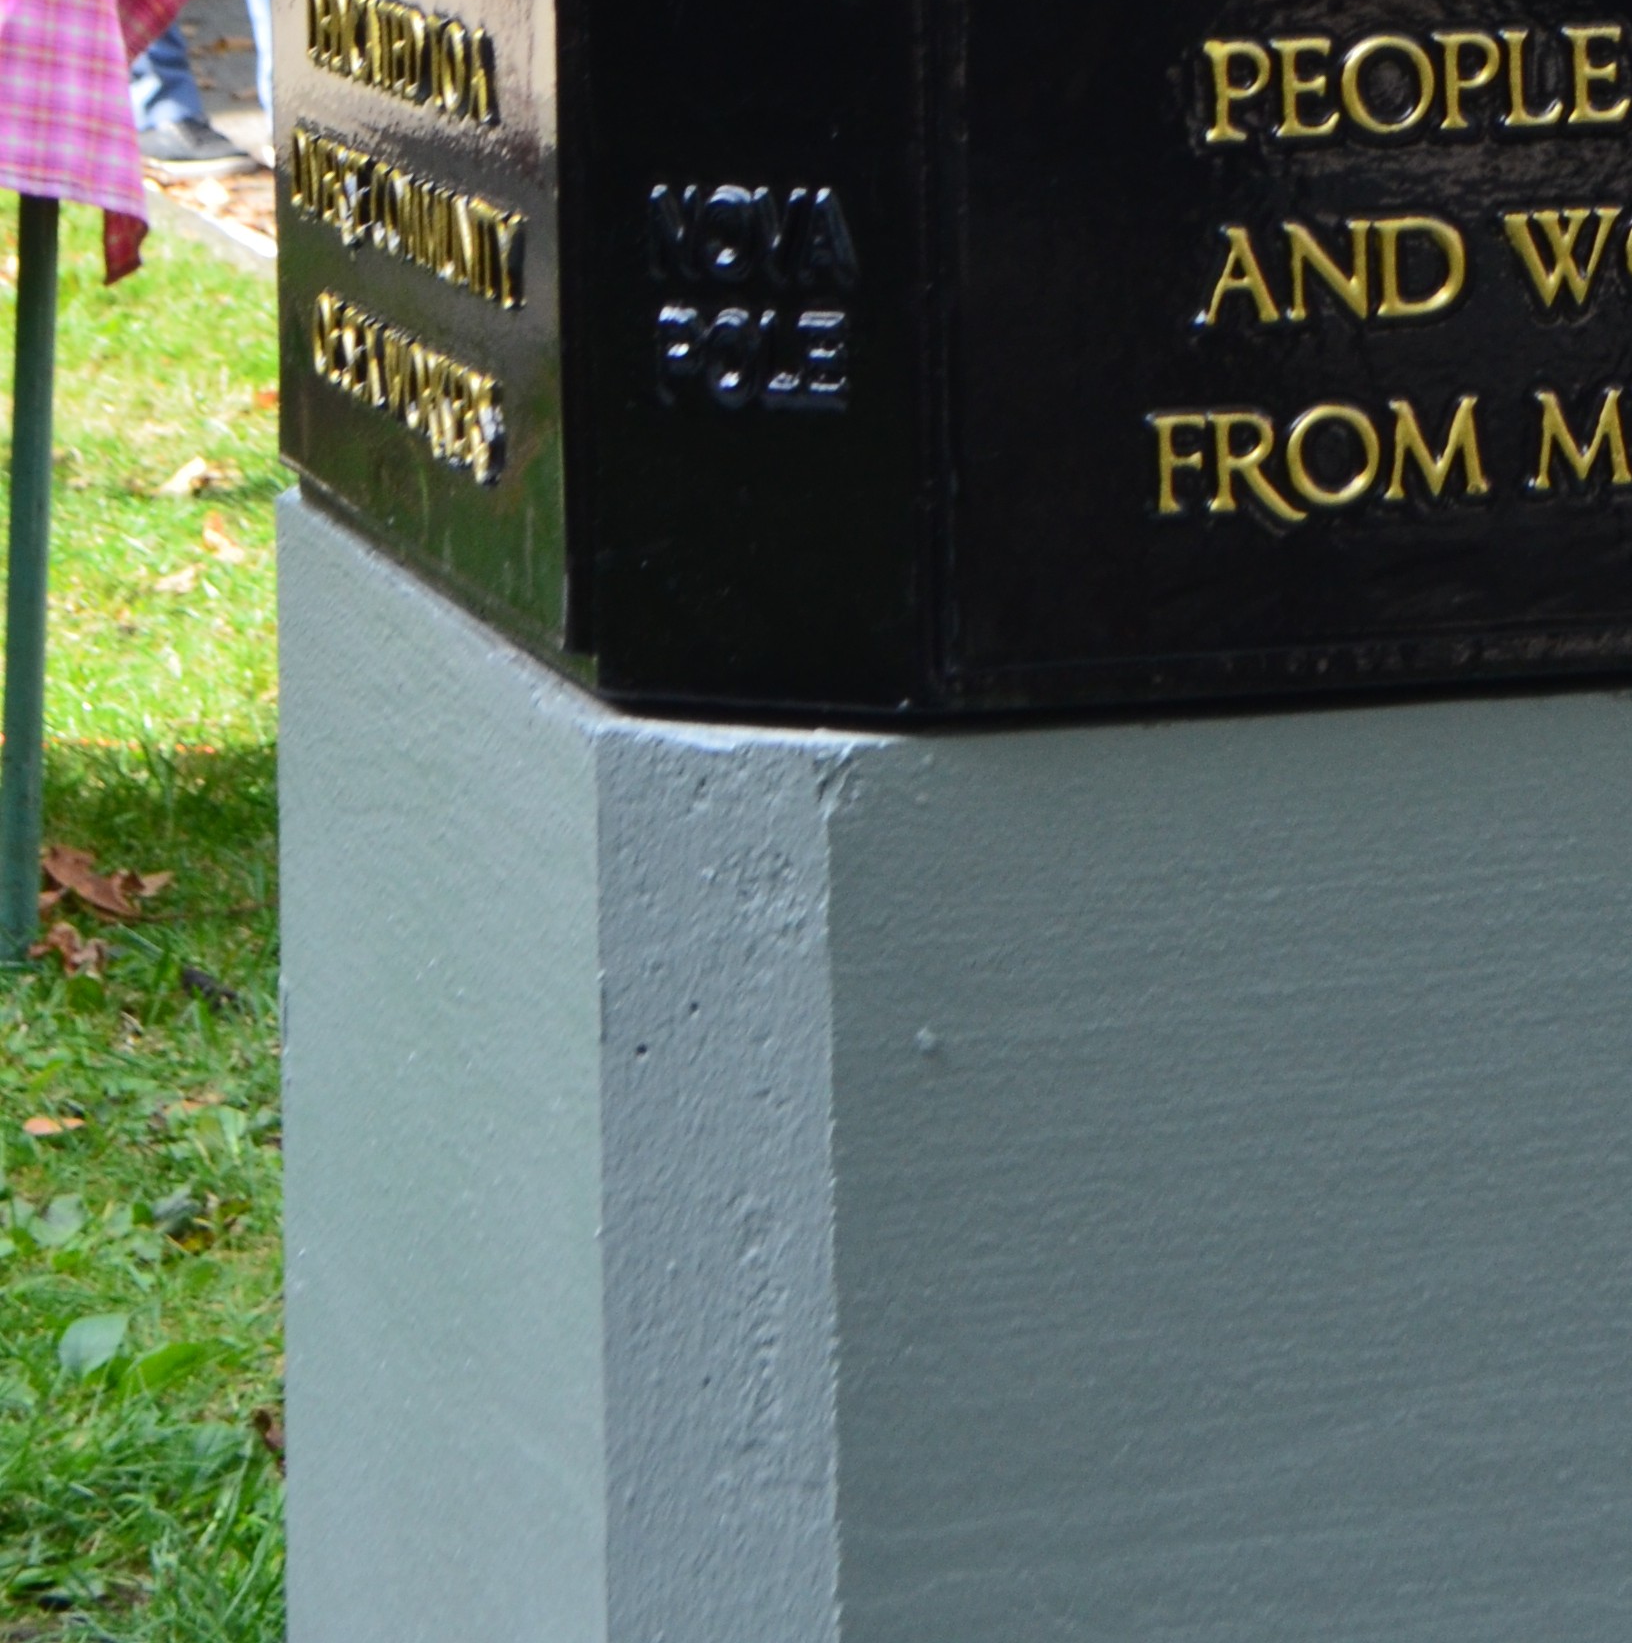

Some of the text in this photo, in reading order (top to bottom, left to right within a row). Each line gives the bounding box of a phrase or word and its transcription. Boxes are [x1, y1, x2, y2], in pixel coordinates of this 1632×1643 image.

[1201, 23, 1632, 144] PEOPLE
[648, 182, 860, 285] NOVA
[1204, 213, 1467, 326] AND
[655, 305, 848, 410] POLE
[1153, 393, 1491, 523] FROM
